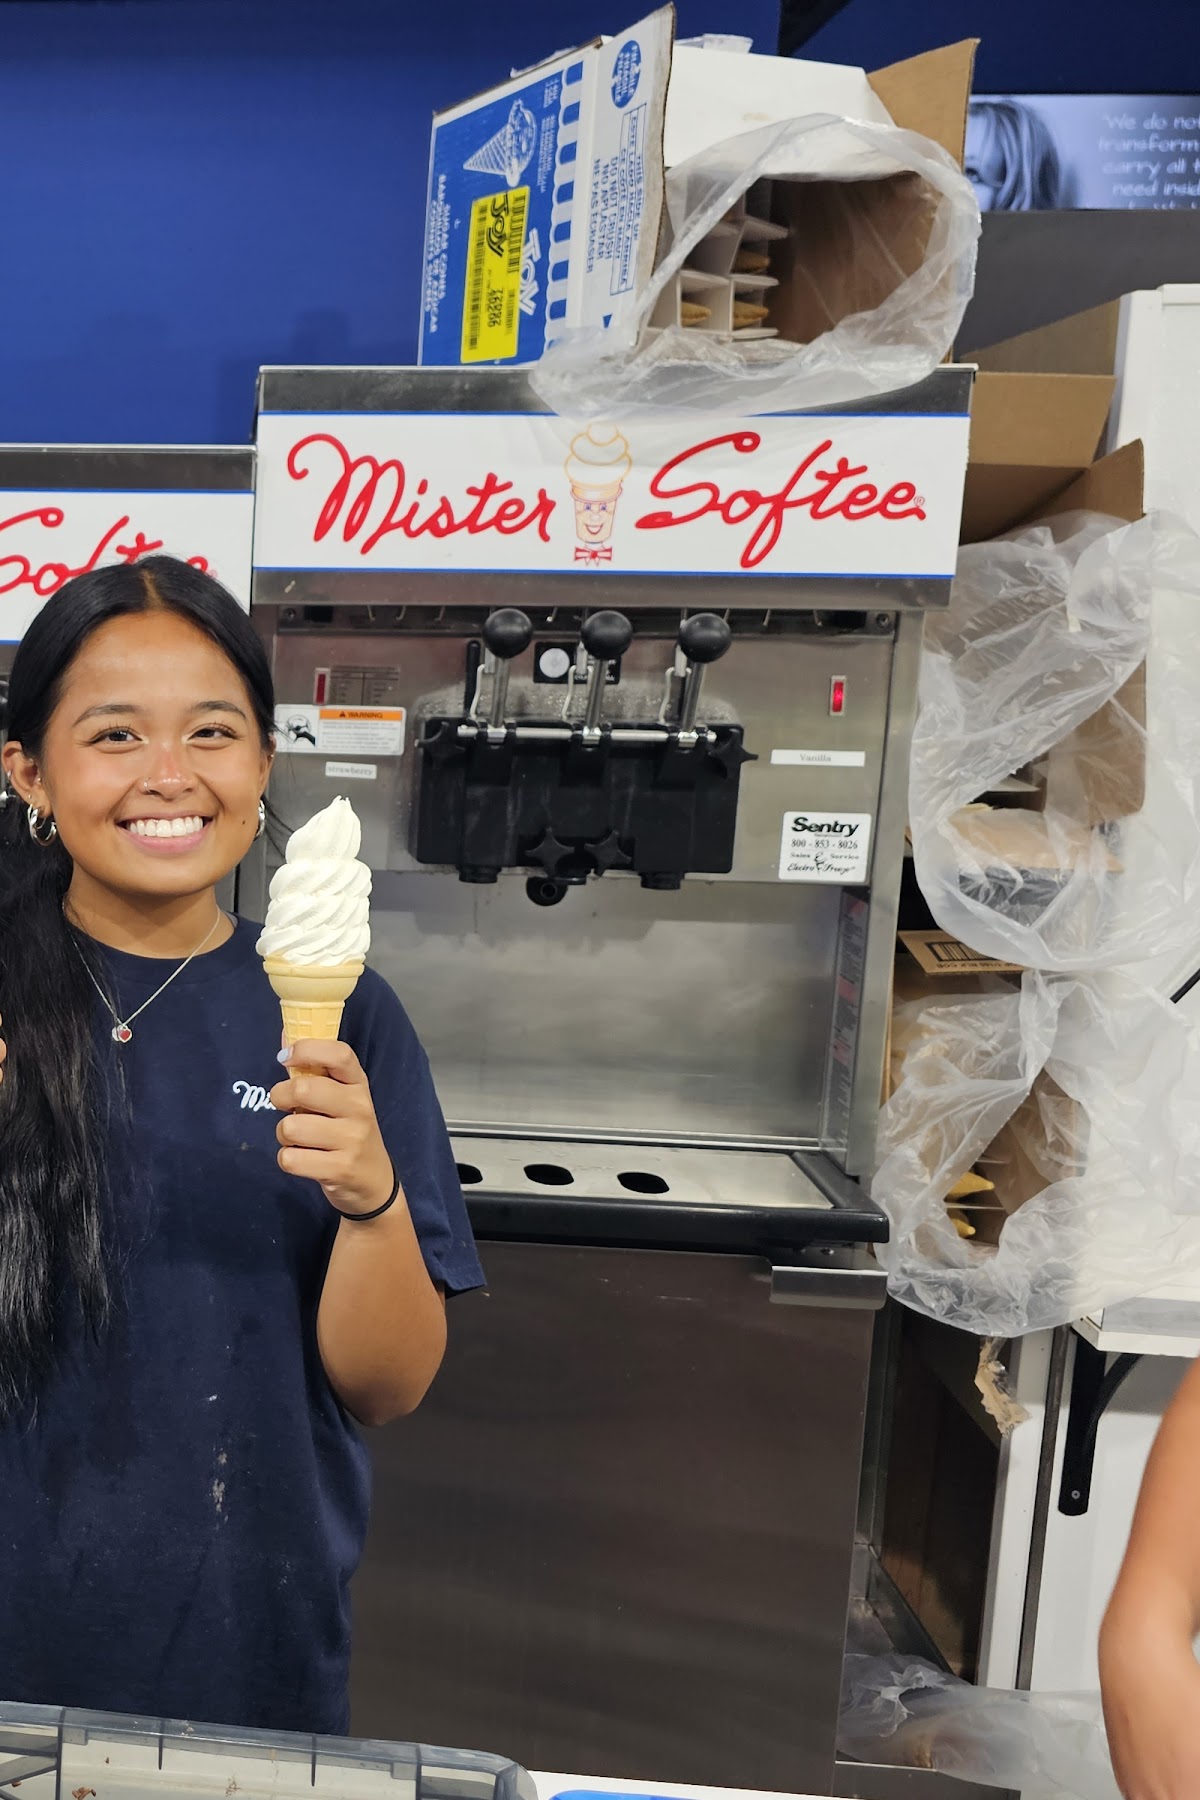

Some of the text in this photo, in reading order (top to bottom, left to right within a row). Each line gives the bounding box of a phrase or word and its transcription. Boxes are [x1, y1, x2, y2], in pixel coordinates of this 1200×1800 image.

[1102, 112, 1137, 130] We
[1143, 112, 1168, 130] do
[1102, 161, 1161, 181] carry
[1166, 157, 1187, 174] all
[591, 181, 600, 210] PAS
[1112, 179, 1159, 196] need
[597, 164, 610, 260] NO APLASTAR
[605, 156, 619, 260] DO NOT CRUSH
[287, 433, 556, 555] Mister
[347, 711, 384, 719] WARNING
[800, 753, 832, 762] Vanilla
[327, 765, 374, 776] strawberry
[791, 816, 860, 838] Sentry
[791, 839, 806, 848] 800
[814, 839, 830, 849] 853
[837, 840, 858, 849] 8026
